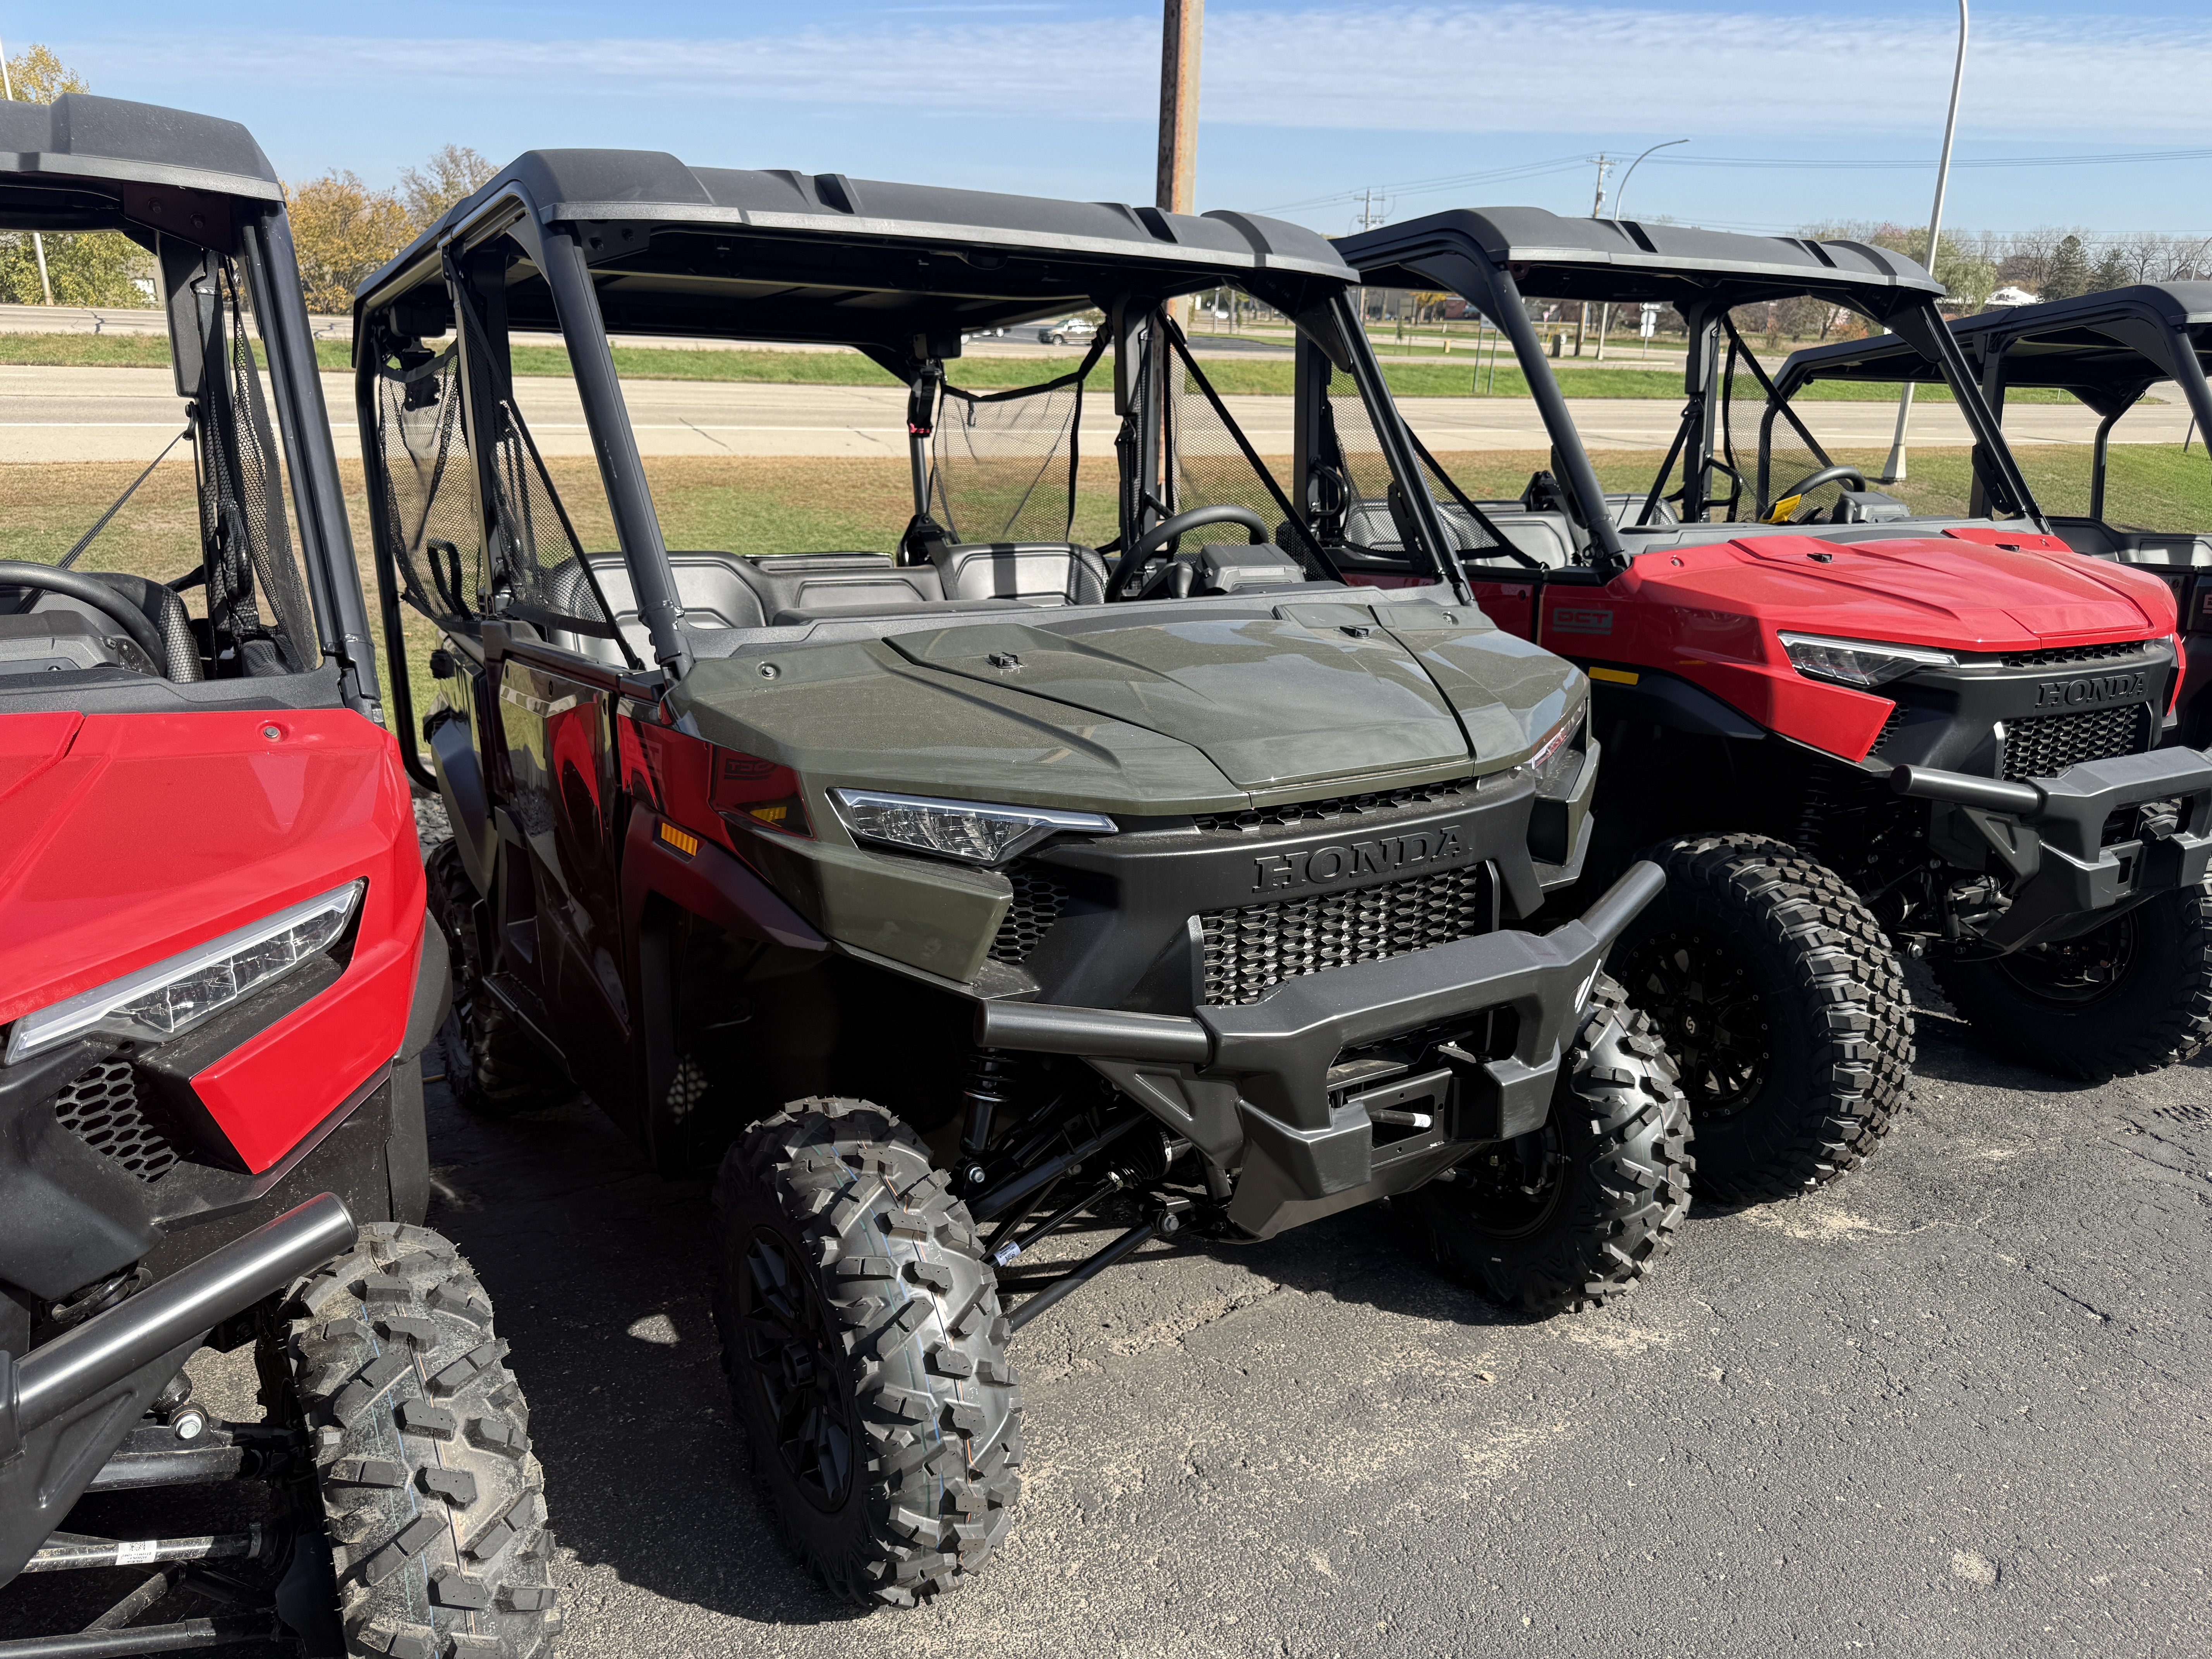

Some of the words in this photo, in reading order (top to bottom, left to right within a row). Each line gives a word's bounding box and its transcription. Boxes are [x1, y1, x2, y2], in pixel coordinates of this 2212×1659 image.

[1557, 611, 1609, 625] DCT
[2035, 672, 2148, 709] HONDA
[1252, 825, 1473, 893] HONDA
